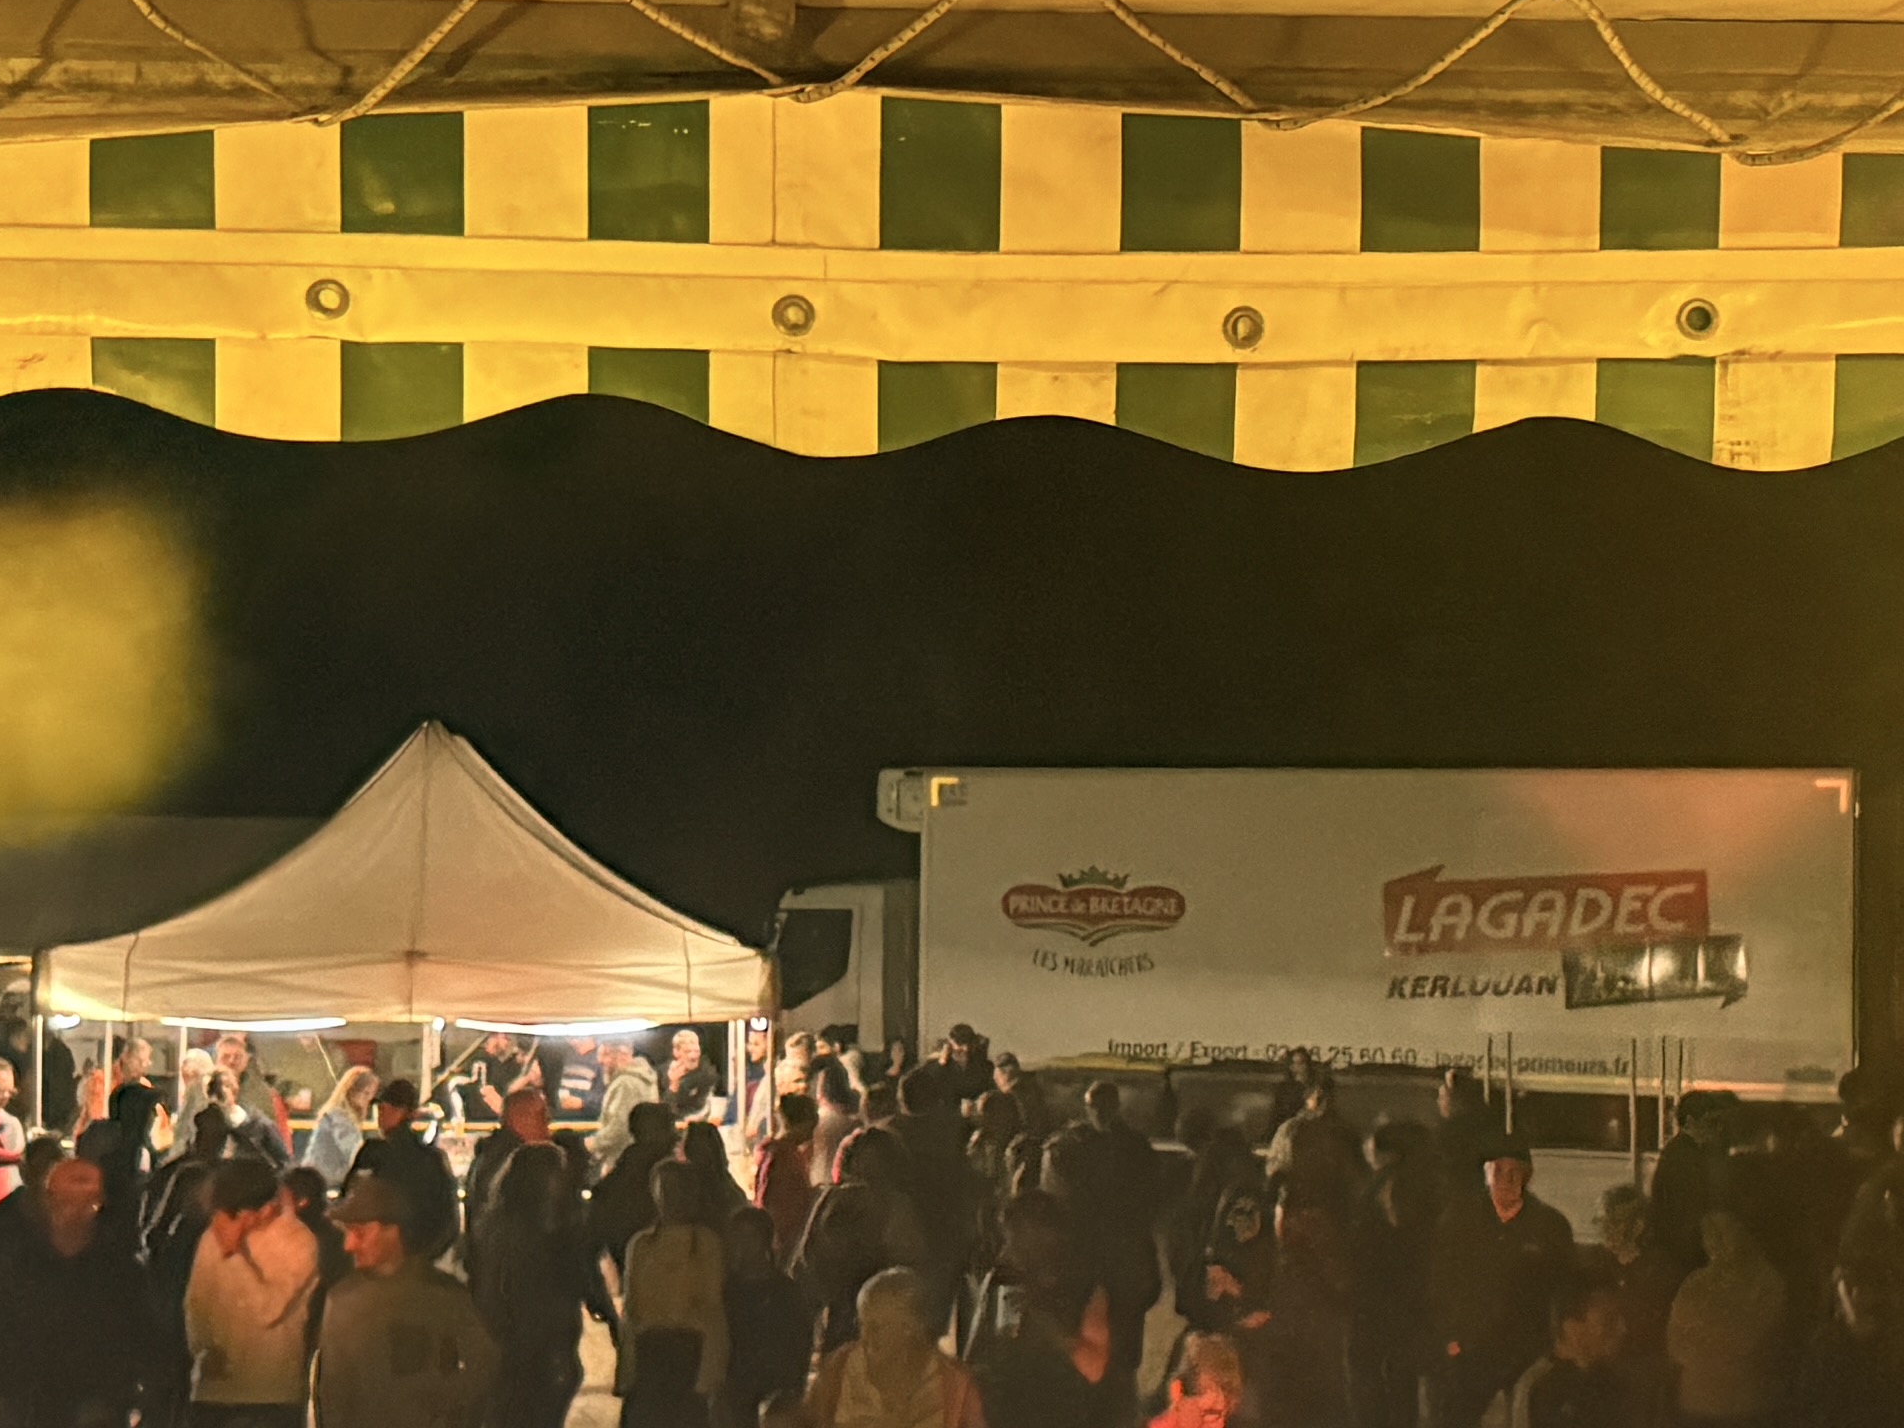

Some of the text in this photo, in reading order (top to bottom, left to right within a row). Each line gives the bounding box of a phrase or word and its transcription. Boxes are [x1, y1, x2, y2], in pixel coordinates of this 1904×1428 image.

[1009, 894, 1070, 915] PRINCE
[1089, 895, 1178, 916] BRETAGNE
[1393, 883, 1695, 943] LAGADEC
